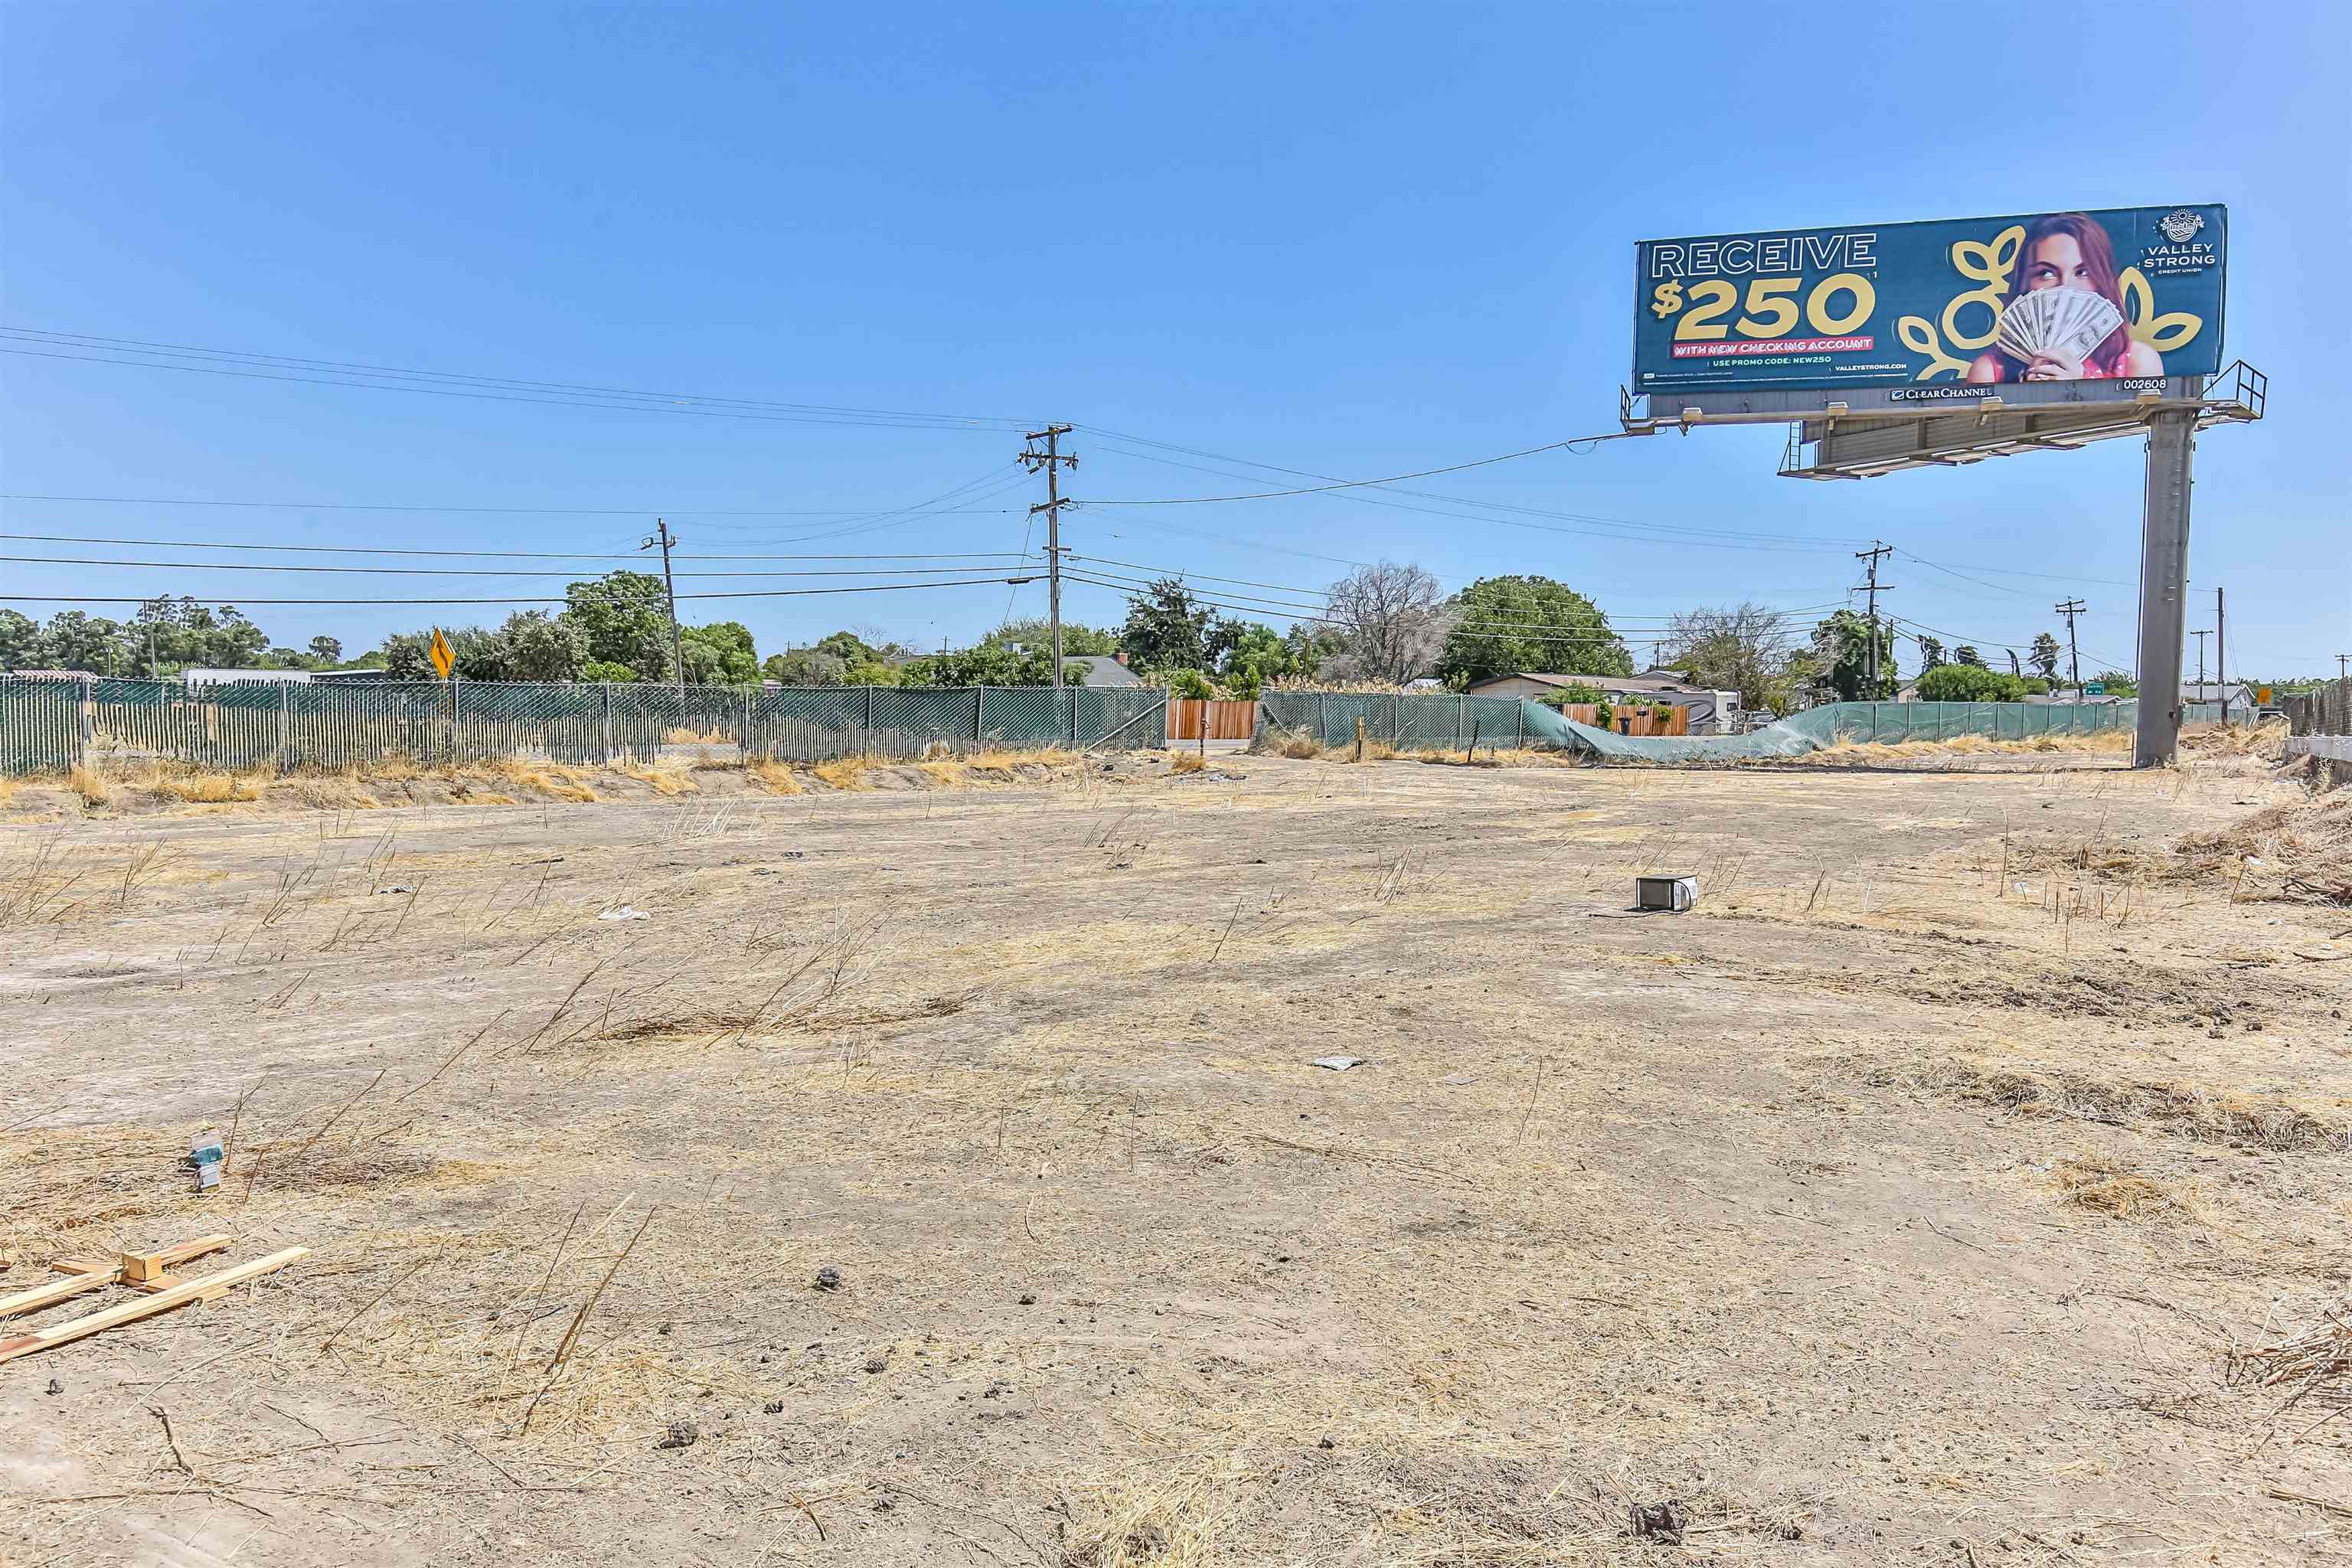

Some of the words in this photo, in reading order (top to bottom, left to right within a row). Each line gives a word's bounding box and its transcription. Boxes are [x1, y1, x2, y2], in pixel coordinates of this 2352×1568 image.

[2148, 243, 2213, 255] VALLEY
[1651, 233, 1877, 278] RECEIVE
[2144, 255, 2216, 267] STRONG
[1651, 273, 1877, 340] $250
[1674, 345, 1707, 355] WITH
[1708, 345, 1737, 354] NEW
[1740, 341, 1805, 353] CHECKING
[1808, 338, 1872, 351] ACCOUNT
[1764, 357, 1792, 365] CODE:
[1792, 355, 1831, 364] NEW250
[1834, 363, 1907, 371] VALLEYSTRONG.COM
[2123, 379, 2167, 390] 002608
